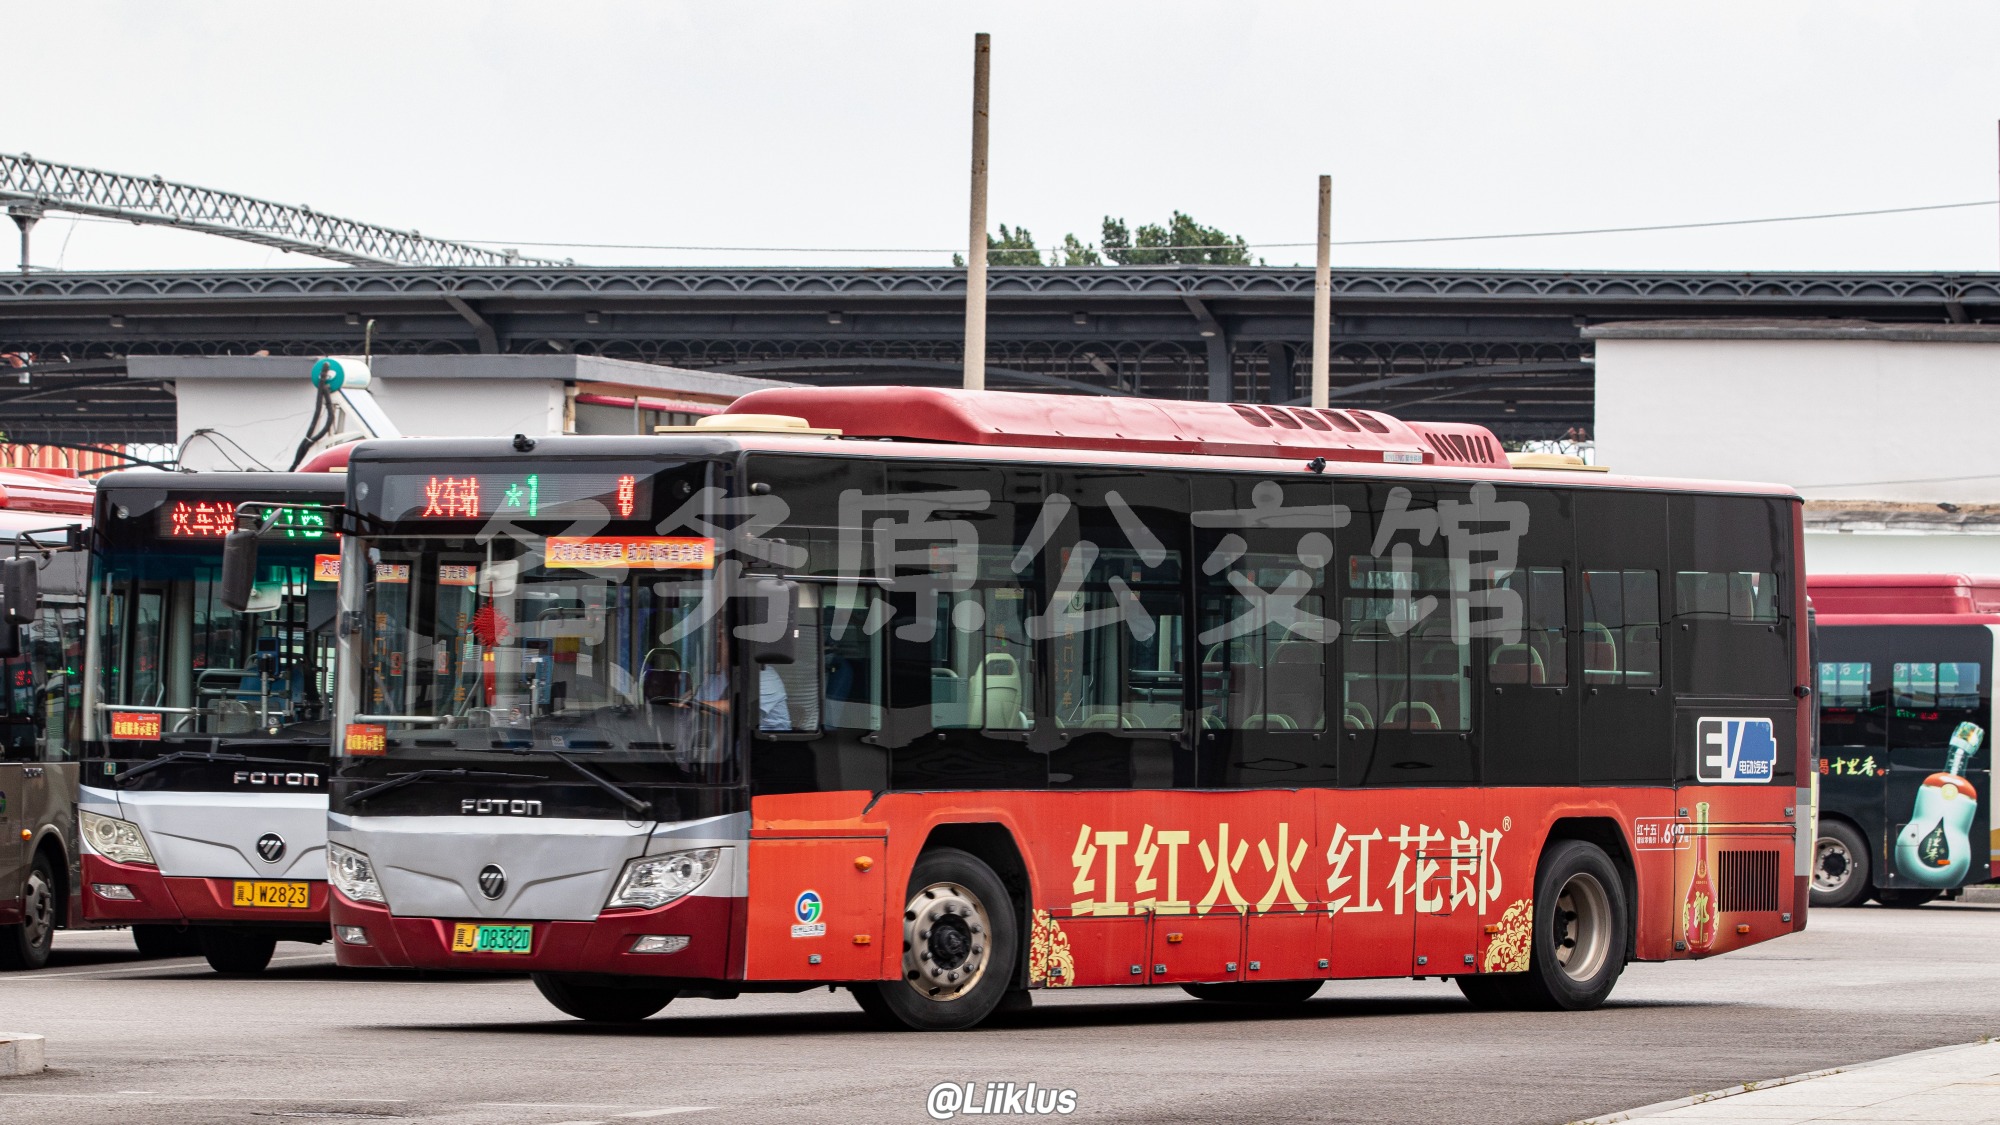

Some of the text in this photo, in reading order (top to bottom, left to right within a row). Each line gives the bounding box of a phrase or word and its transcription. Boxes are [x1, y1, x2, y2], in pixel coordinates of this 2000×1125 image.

[422, 476, 480, 517] 火车站
[1699, 721, 1745, 779] EV
[1738, 760, 1769, 774] 电动汽车
[234, 772, 319, 786] FOTON
[461, 799, 543, 815] FOTON
[1637, 824, 1657, 836] 红十五
